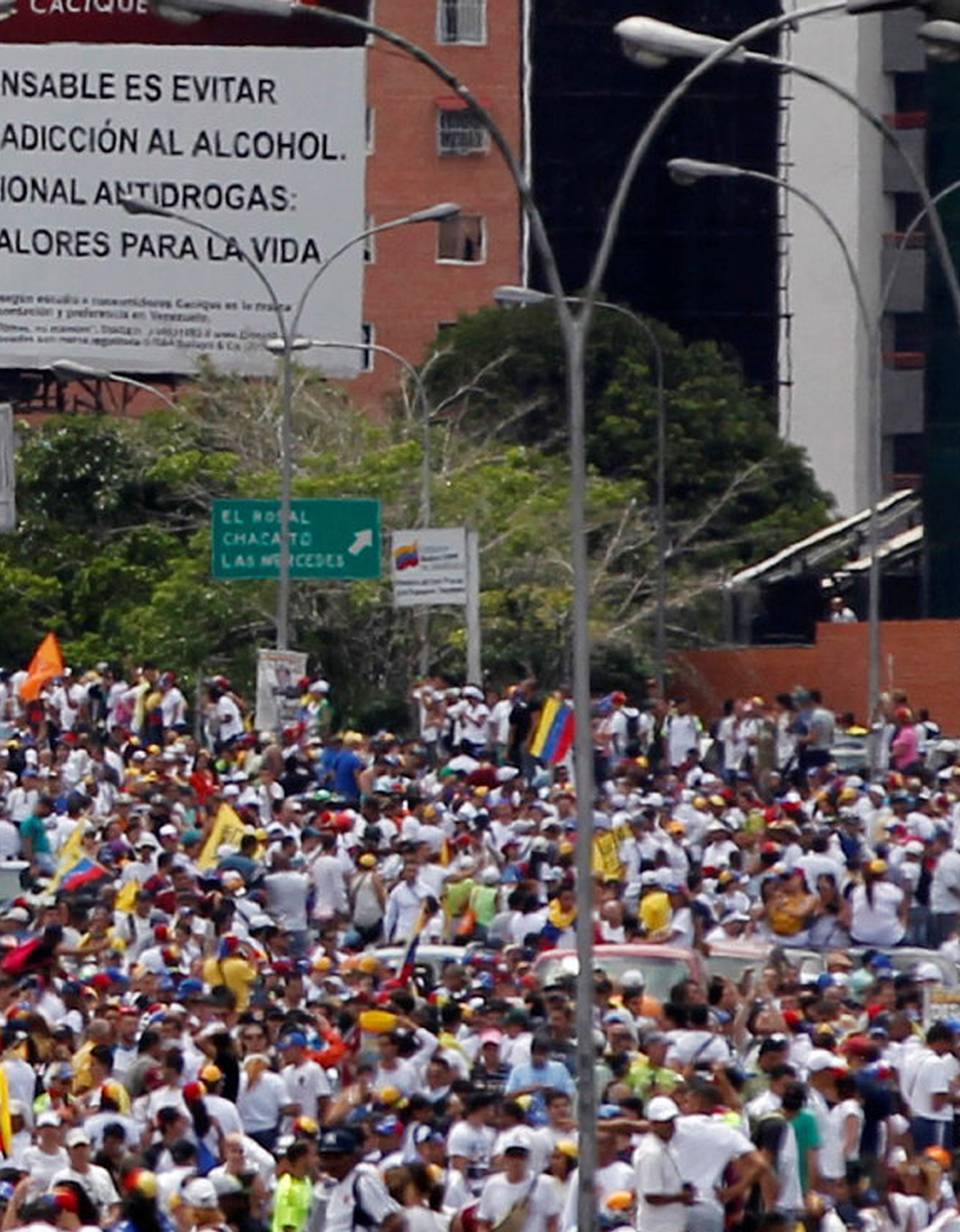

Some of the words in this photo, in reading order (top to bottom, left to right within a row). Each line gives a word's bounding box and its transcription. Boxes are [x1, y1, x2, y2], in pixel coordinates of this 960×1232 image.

[126, 74, 162, 102] ES
[173, 75, 276, 104] EVITAR
[1, 119, 138, 154] ADICCIÓN
[148, 128, 184, 156] AL
[192, 130, 346, 160] ALCOHOL.
[121, 232, 199, 260] PARA
[207, 234, 244, 262] LA
[252, 238, 321, 264] VIDA
[222, 510, 243, 525] EL
[223, 532, 312, 547] CHACATO
[222, 553, 256, 569] LAS
